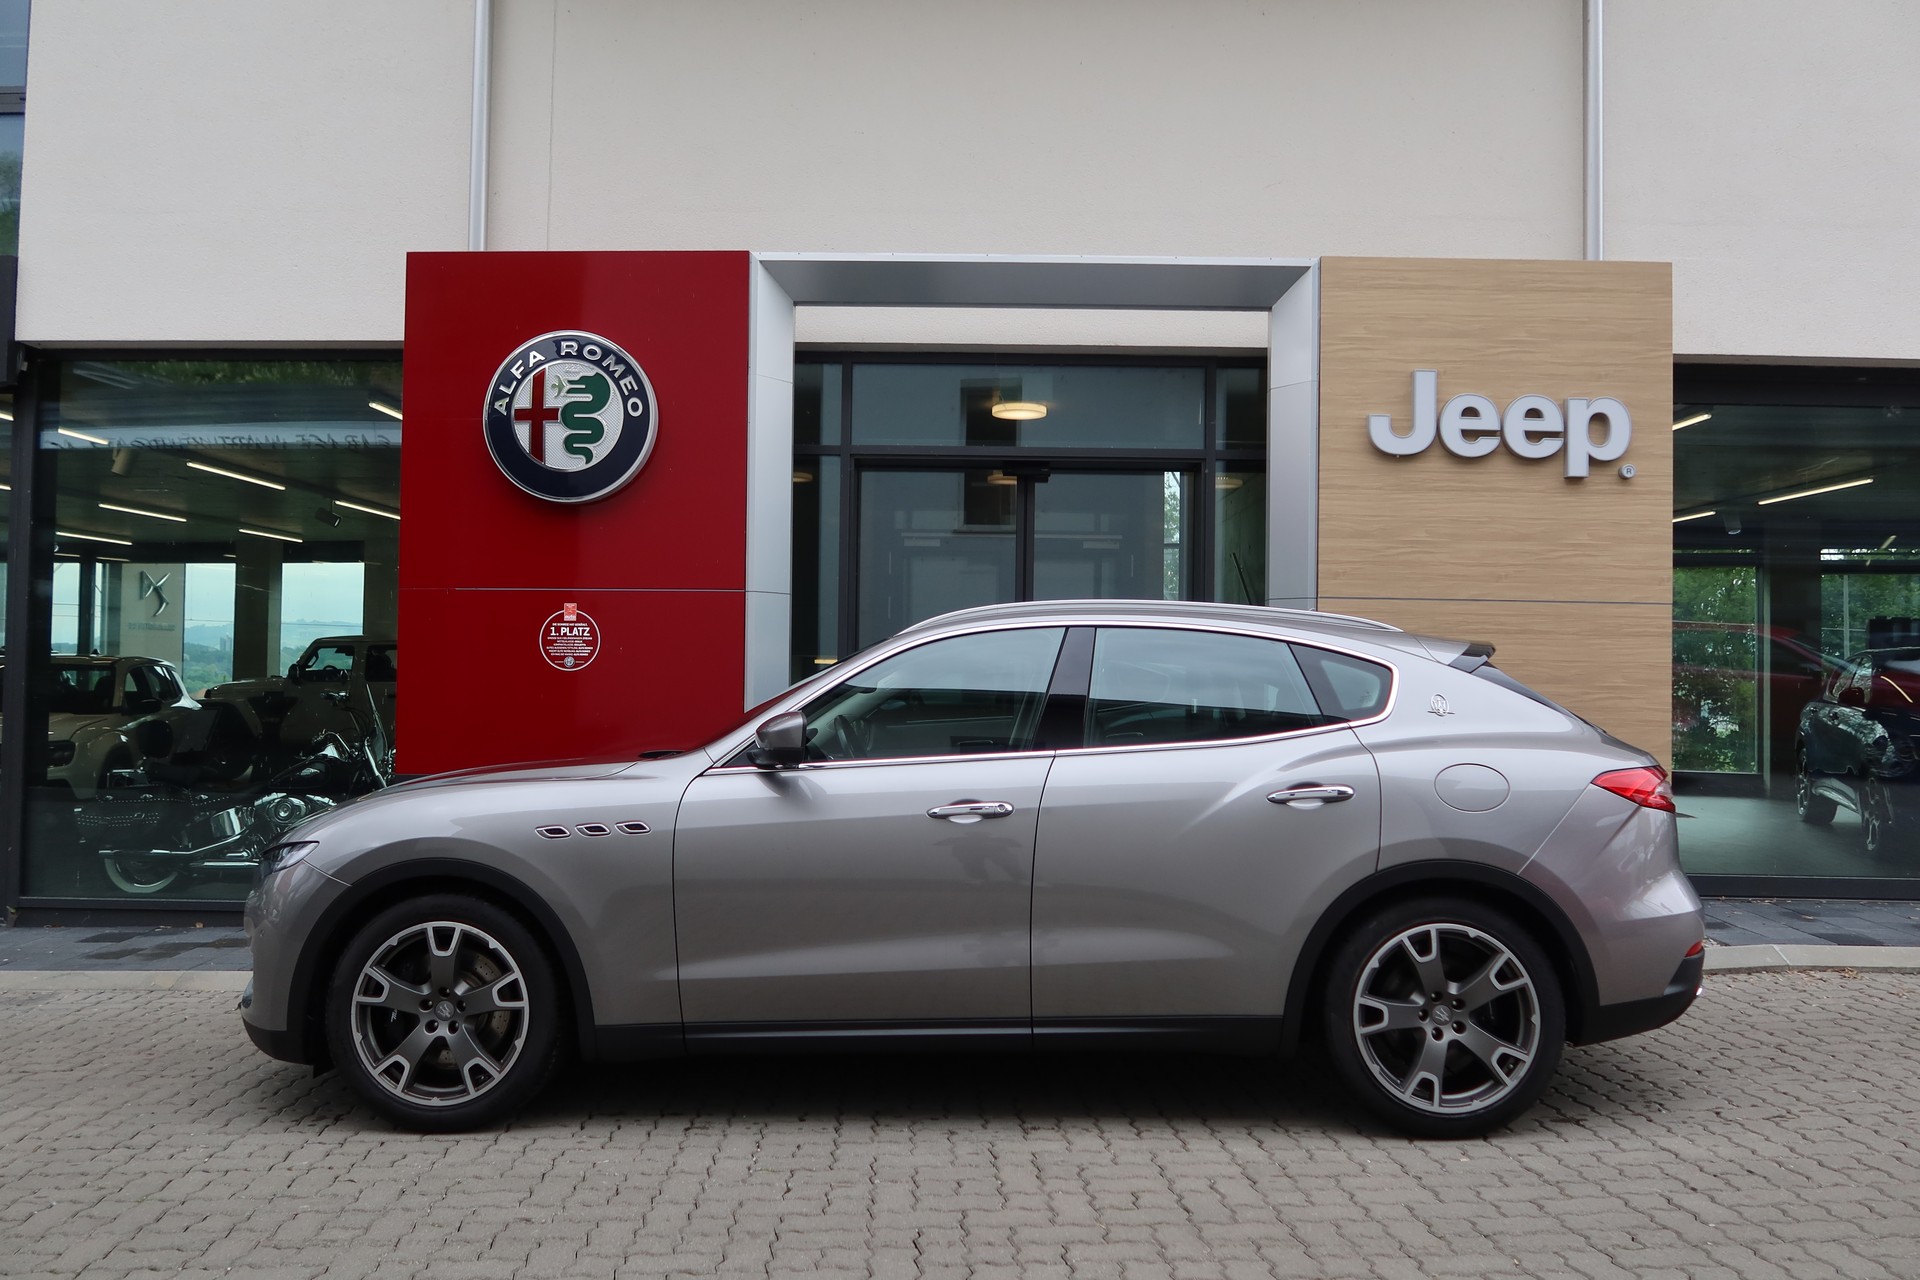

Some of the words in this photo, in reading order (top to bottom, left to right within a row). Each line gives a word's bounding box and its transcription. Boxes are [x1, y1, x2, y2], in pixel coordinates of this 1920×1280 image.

[494, 350, 546, 416] ALFA
[560, 341, 644, 418] ROMEO
[1368, 369, 1632, 479] Jeep
[550, 626, 559, 636] 1.
[560, 626, 591, 636] PLATZ
